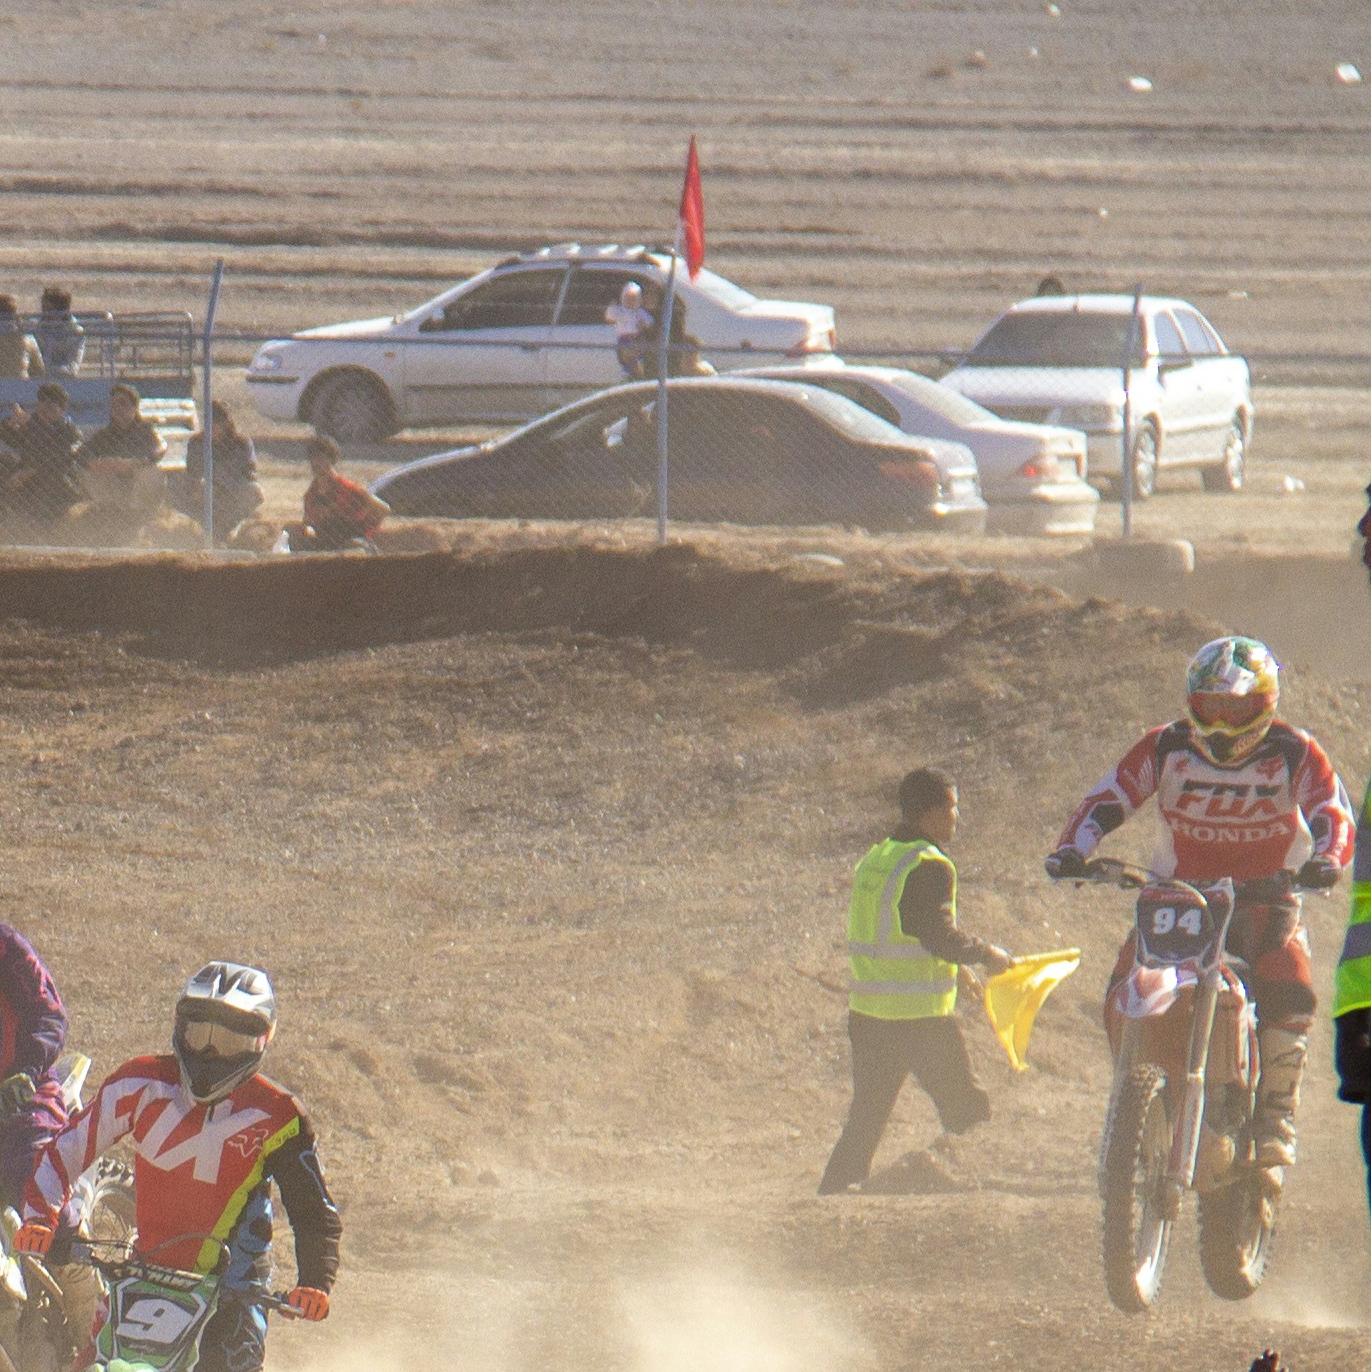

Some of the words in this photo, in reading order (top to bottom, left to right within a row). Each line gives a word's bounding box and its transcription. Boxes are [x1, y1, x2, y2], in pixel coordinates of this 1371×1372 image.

[1175, 779, 1282, 818] FOX
[1170, 817, 1291, 842] HONDA
[1153, 907, 1203, 936] 94
[95, 1077, 272, 1185] FOX
[115, 1298, 194, 1344] 9
